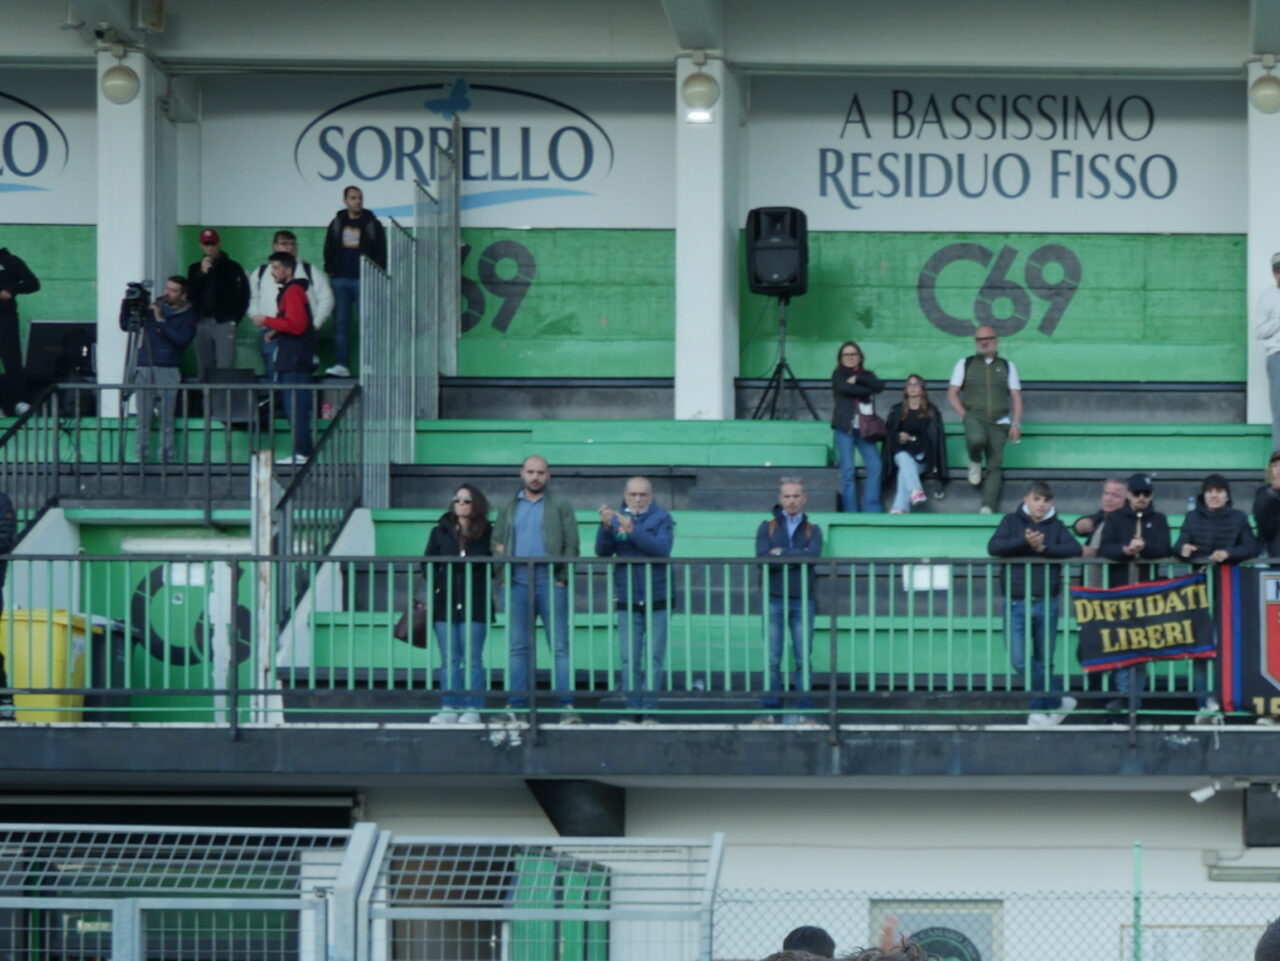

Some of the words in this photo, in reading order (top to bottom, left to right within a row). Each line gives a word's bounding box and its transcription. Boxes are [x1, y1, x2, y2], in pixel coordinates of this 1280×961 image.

[840, 93, 872, 139] A
[892, 90, 1156, 142] BASSISSIMO
[819, 148, 1031, 210] RESIDUO
[1051, 150, 1178, 199] FISSO
[917, 243, 1083, 338] C69
[1074, 584, 1209, 624] DIFFIDATI
[1100, 620, 1195, 653] LIBERI
